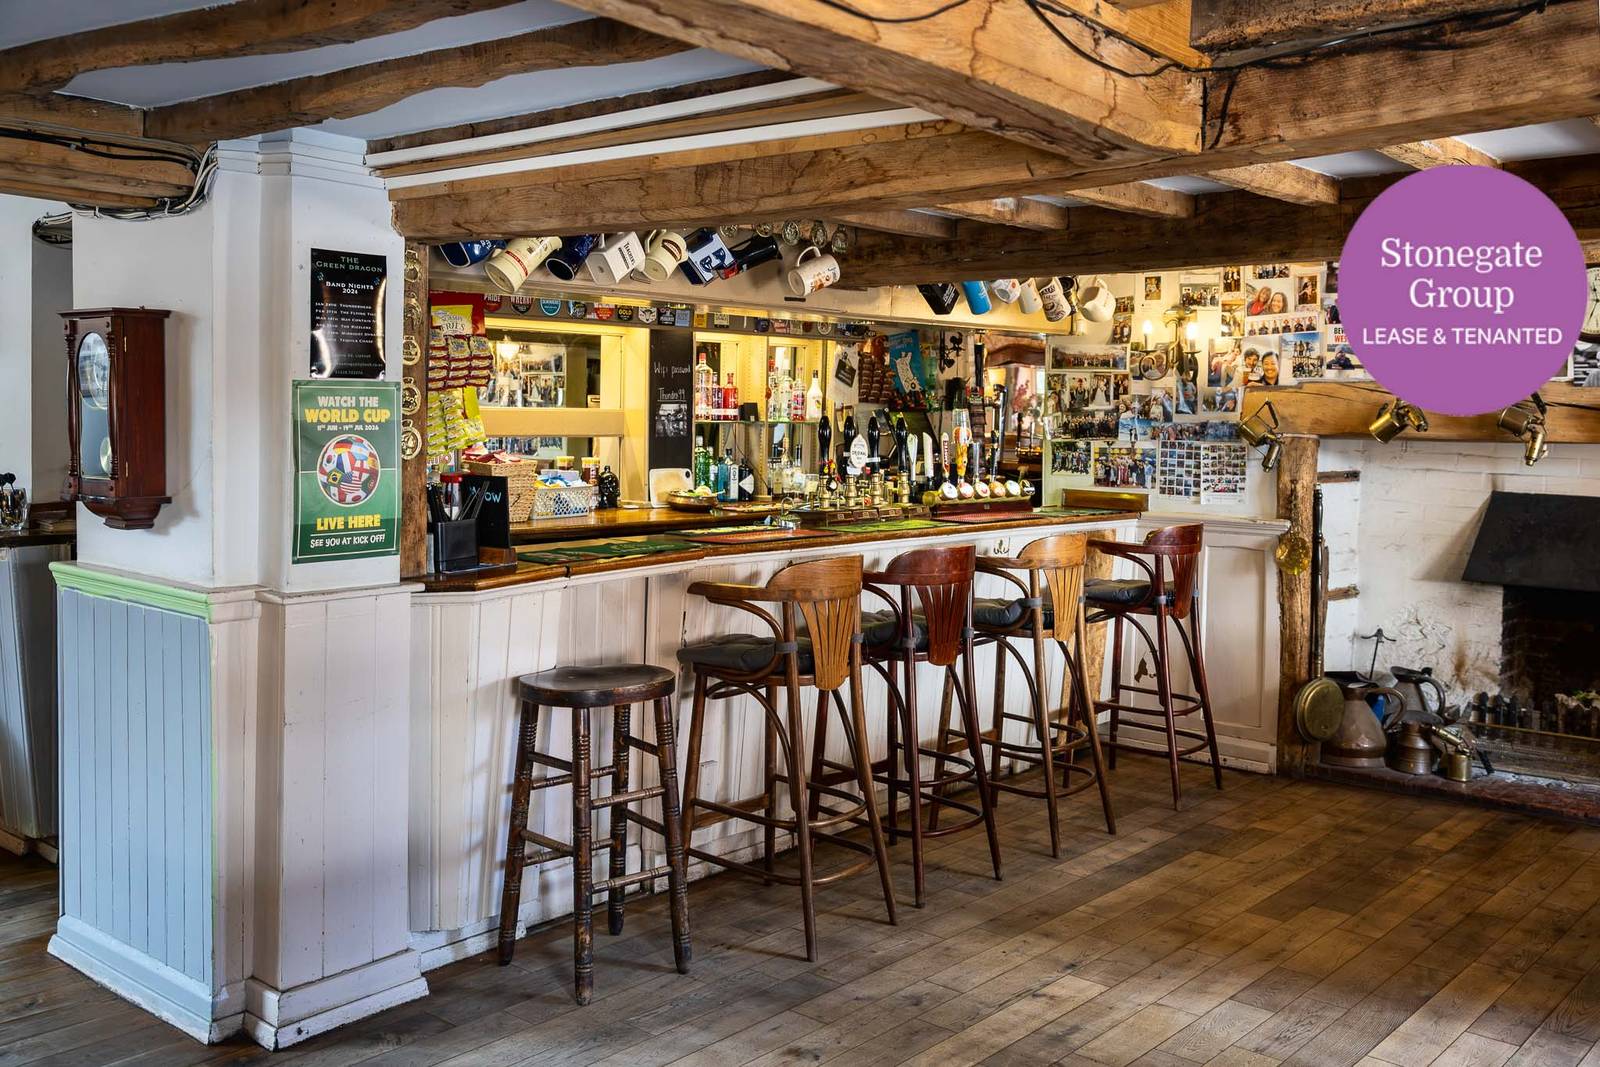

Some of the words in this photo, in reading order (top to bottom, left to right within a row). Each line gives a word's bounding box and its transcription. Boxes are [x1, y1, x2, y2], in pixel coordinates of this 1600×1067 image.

[316, 261, 346, 269] GREEN
[318, 396, 356, 407] WATCH
[359, 396, 379, 407] THE
[304, 408, 360, 423] WORLD
[363, 408, 391, 423] CUP
[316, 516, 344, 530] LIVE
[348, 514, 381, 528] HERE
[310, 539, 324, 548] SEE
[325, 538, 340, 547] YOU
[342, 537, 351, 545] AT
[353, 536, 368, 544] KICK
[370, 534, 385, 542] OFF!
